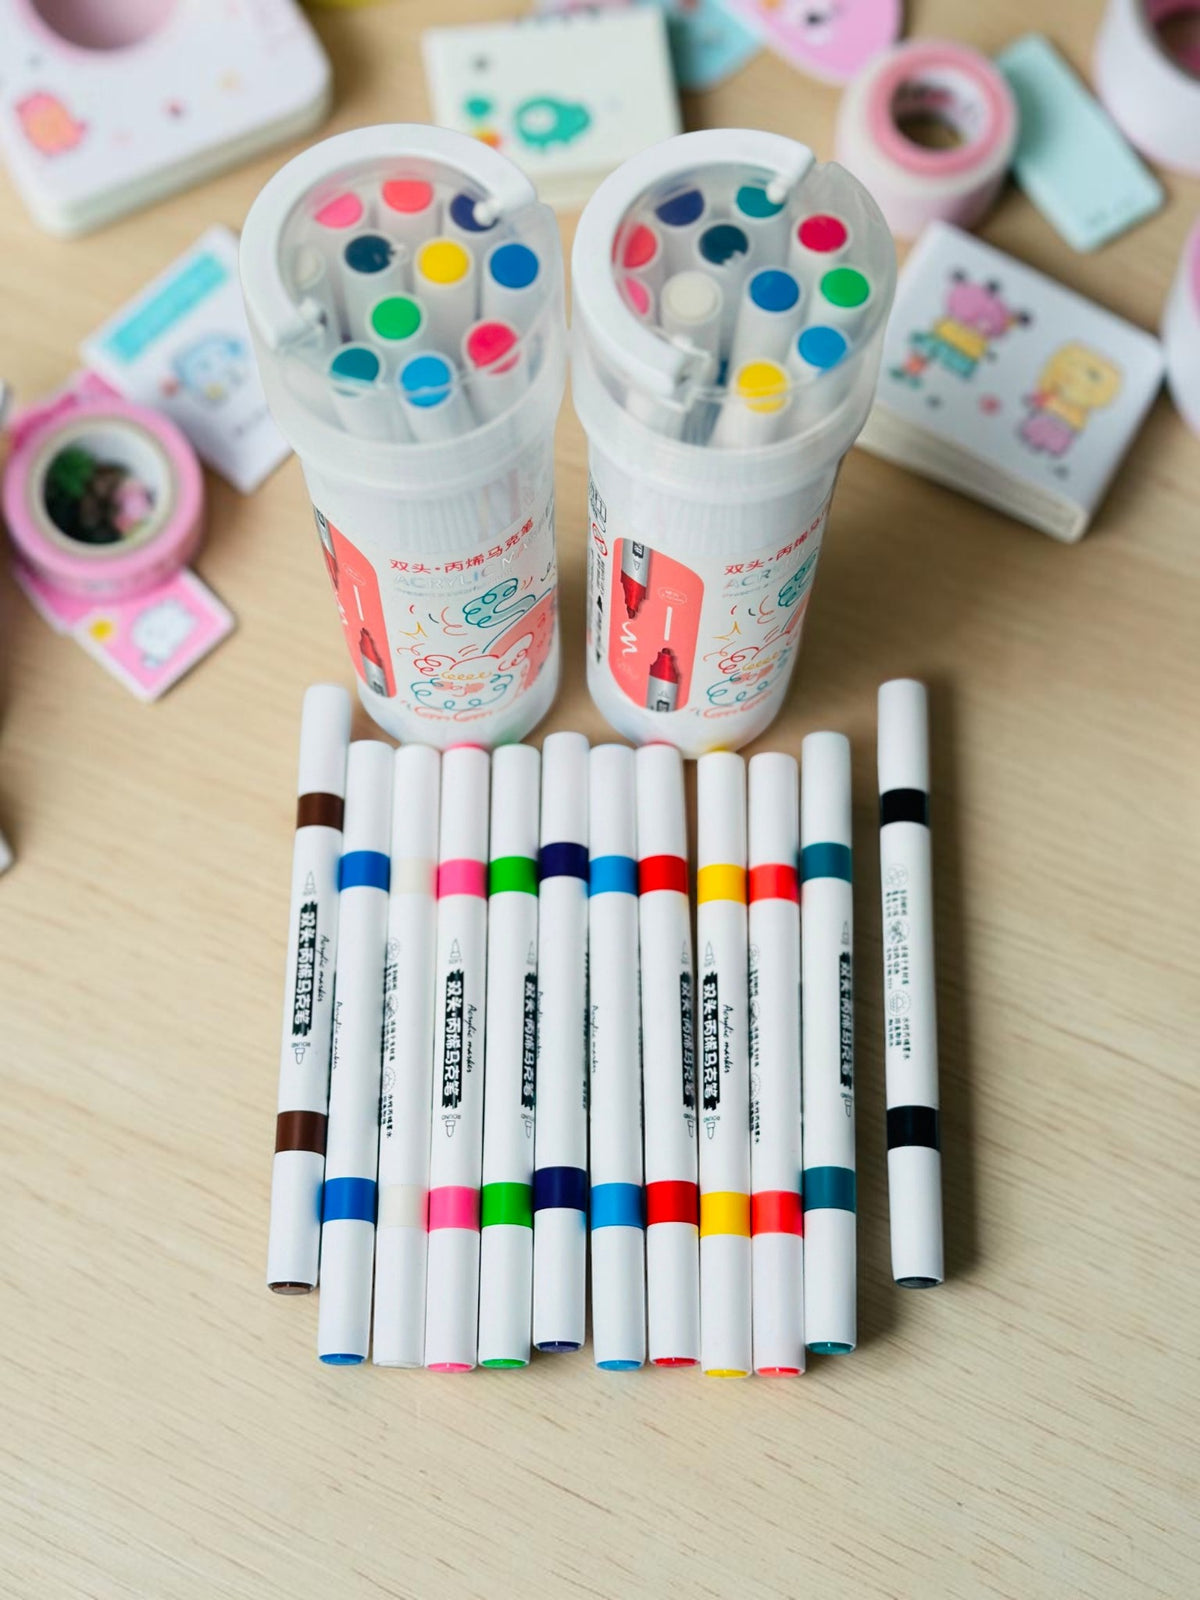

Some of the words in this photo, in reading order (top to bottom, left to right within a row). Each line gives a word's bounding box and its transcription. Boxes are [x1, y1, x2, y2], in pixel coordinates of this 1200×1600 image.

[316, 934, 330, 967] Acrylic
[294, 911, 316, 1025] 双头·丙烯马克笔
[318, 970, 327, 1002] marker
[464, 1003, 477, 1037] Acrylic
[720, 1003, 734, 1038] Acrylic
[444, 981, 462, 1097] 双头·丙烯马克笔
[703, 982, 718, 1099] 双头·丙烯马克笔
[466, 1040, 476, 1073] marker
[723, 1041, 734, 1074] marker
